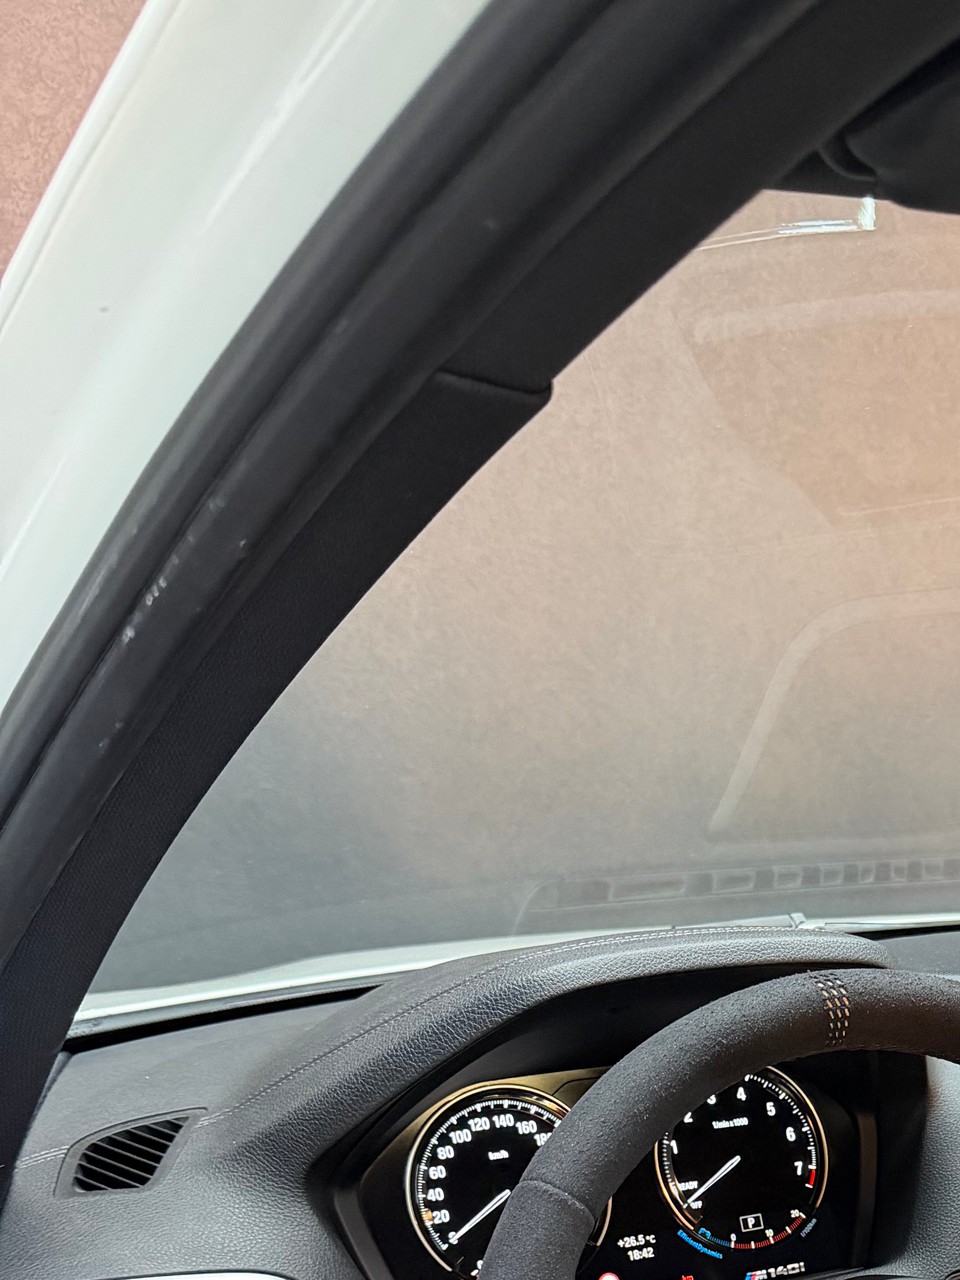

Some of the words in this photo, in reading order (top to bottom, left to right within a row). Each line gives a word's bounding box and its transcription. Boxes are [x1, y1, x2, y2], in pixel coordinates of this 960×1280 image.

[736, 1087, 746, 1101] 4
[766, 1102, 776, 1116] 5
[468, 1117, 490, 1132] 120
[493, 1114, 514, 1128] 140
[516, 1120, 537, 1134] 160
[449, 1129, 472, 1144] 100
[534, 1132, 552, 1146] 18
[786, 1127, 796, 1141] 6
[437, 1146, 454, 1160] 80
[670, 1140, 678, 1154] 1
[488, 1150, 509, 1160] km/h
[429, 1165, 446, 1180] 60
[794, 1161, 803, 1175] 7
[427, 1188, 444, 1201] 40
[433, 1210, 450, 1224] 20
[790, 1209, 800, 1218] 20
[747, 1217, 755, 1229] P
[730, 1233, 736, 1242] 0
[765, 1229, 774, 1238] 10
[627, 1247, 655, 1261] 18:42
